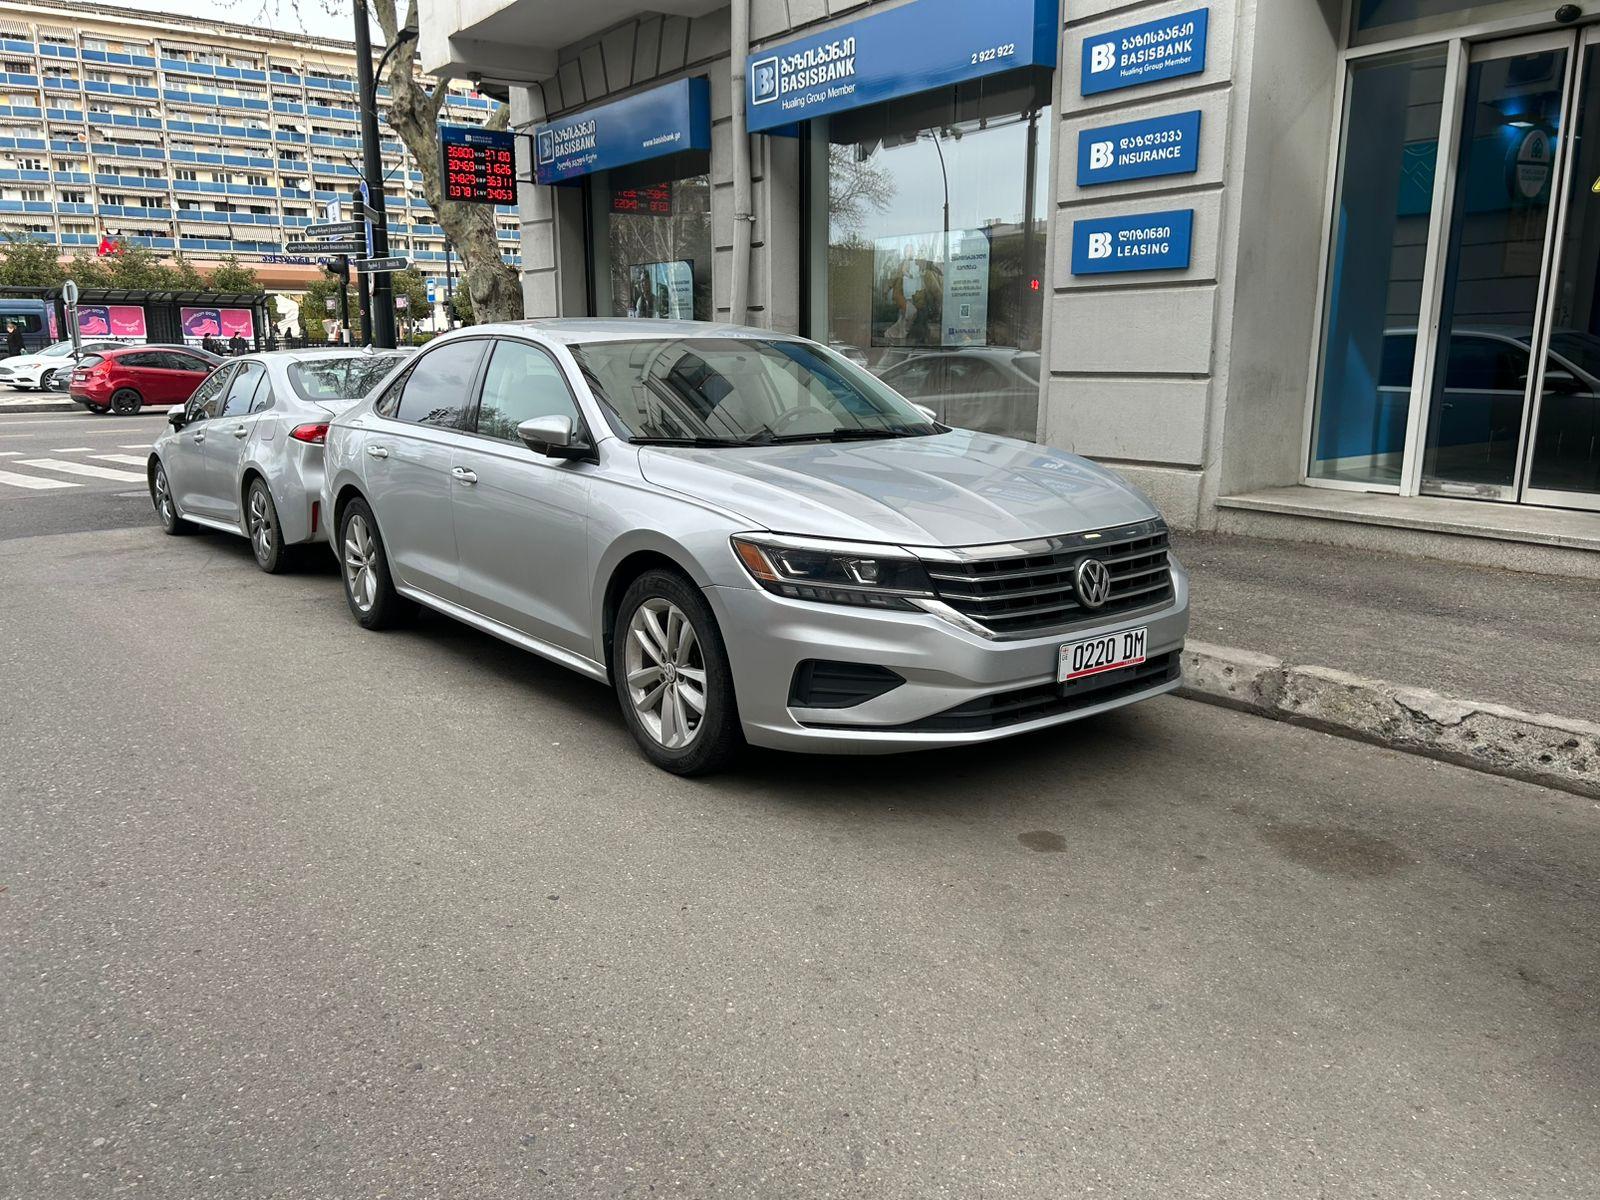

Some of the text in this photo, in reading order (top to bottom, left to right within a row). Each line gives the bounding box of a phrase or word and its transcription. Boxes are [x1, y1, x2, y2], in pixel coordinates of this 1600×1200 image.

[1121, 21, 1194, 51] ბაზისბანკი
[780, 36, 856, 75] ბაზისბანკი
[971, 43, 1015, 64] 2 922 922
[1120, 39, 1193, 67] BASISBANK
[781, 57, 856, 94] BASISBANK
[1120, 55, 1192, 77] Hualing Group Member
[782, 83, 856, 110] Hualing Group Member
[555, 134, 597, 157] BASISBANK
[1119, 130, 1182, 149] დაზღვევა
[1118, 146, 1181, 166] INSURANCE
[1118, 226, 1171, 242] ლიზინგი
[1117, 243, 1170, 257] LEASING
[1073, 631, 1145, 672] 0220 DM
